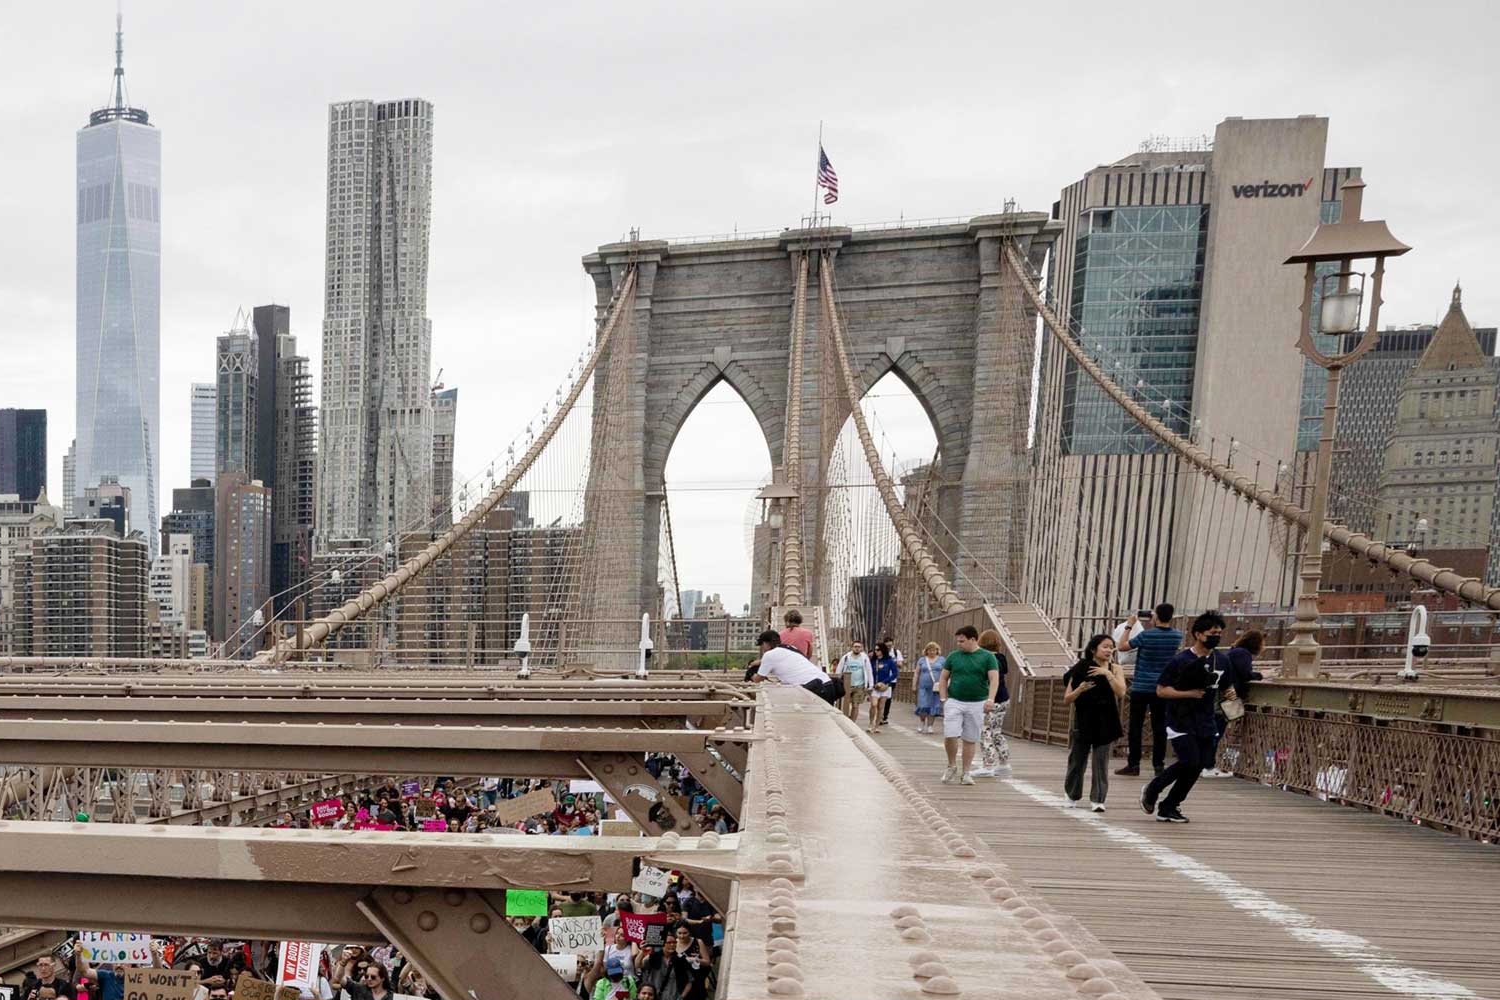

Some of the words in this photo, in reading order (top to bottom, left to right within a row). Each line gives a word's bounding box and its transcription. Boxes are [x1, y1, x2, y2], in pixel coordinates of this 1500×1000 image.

[1232, 179, 1303, 199] verizon
[569, 933, 598, 949] BODY
[285, 959, 297, 975] MY
[297, 966, 308, 980] MY
[127, 973, 143, 984] WE
[149, 973, 192, 987] WON'T
